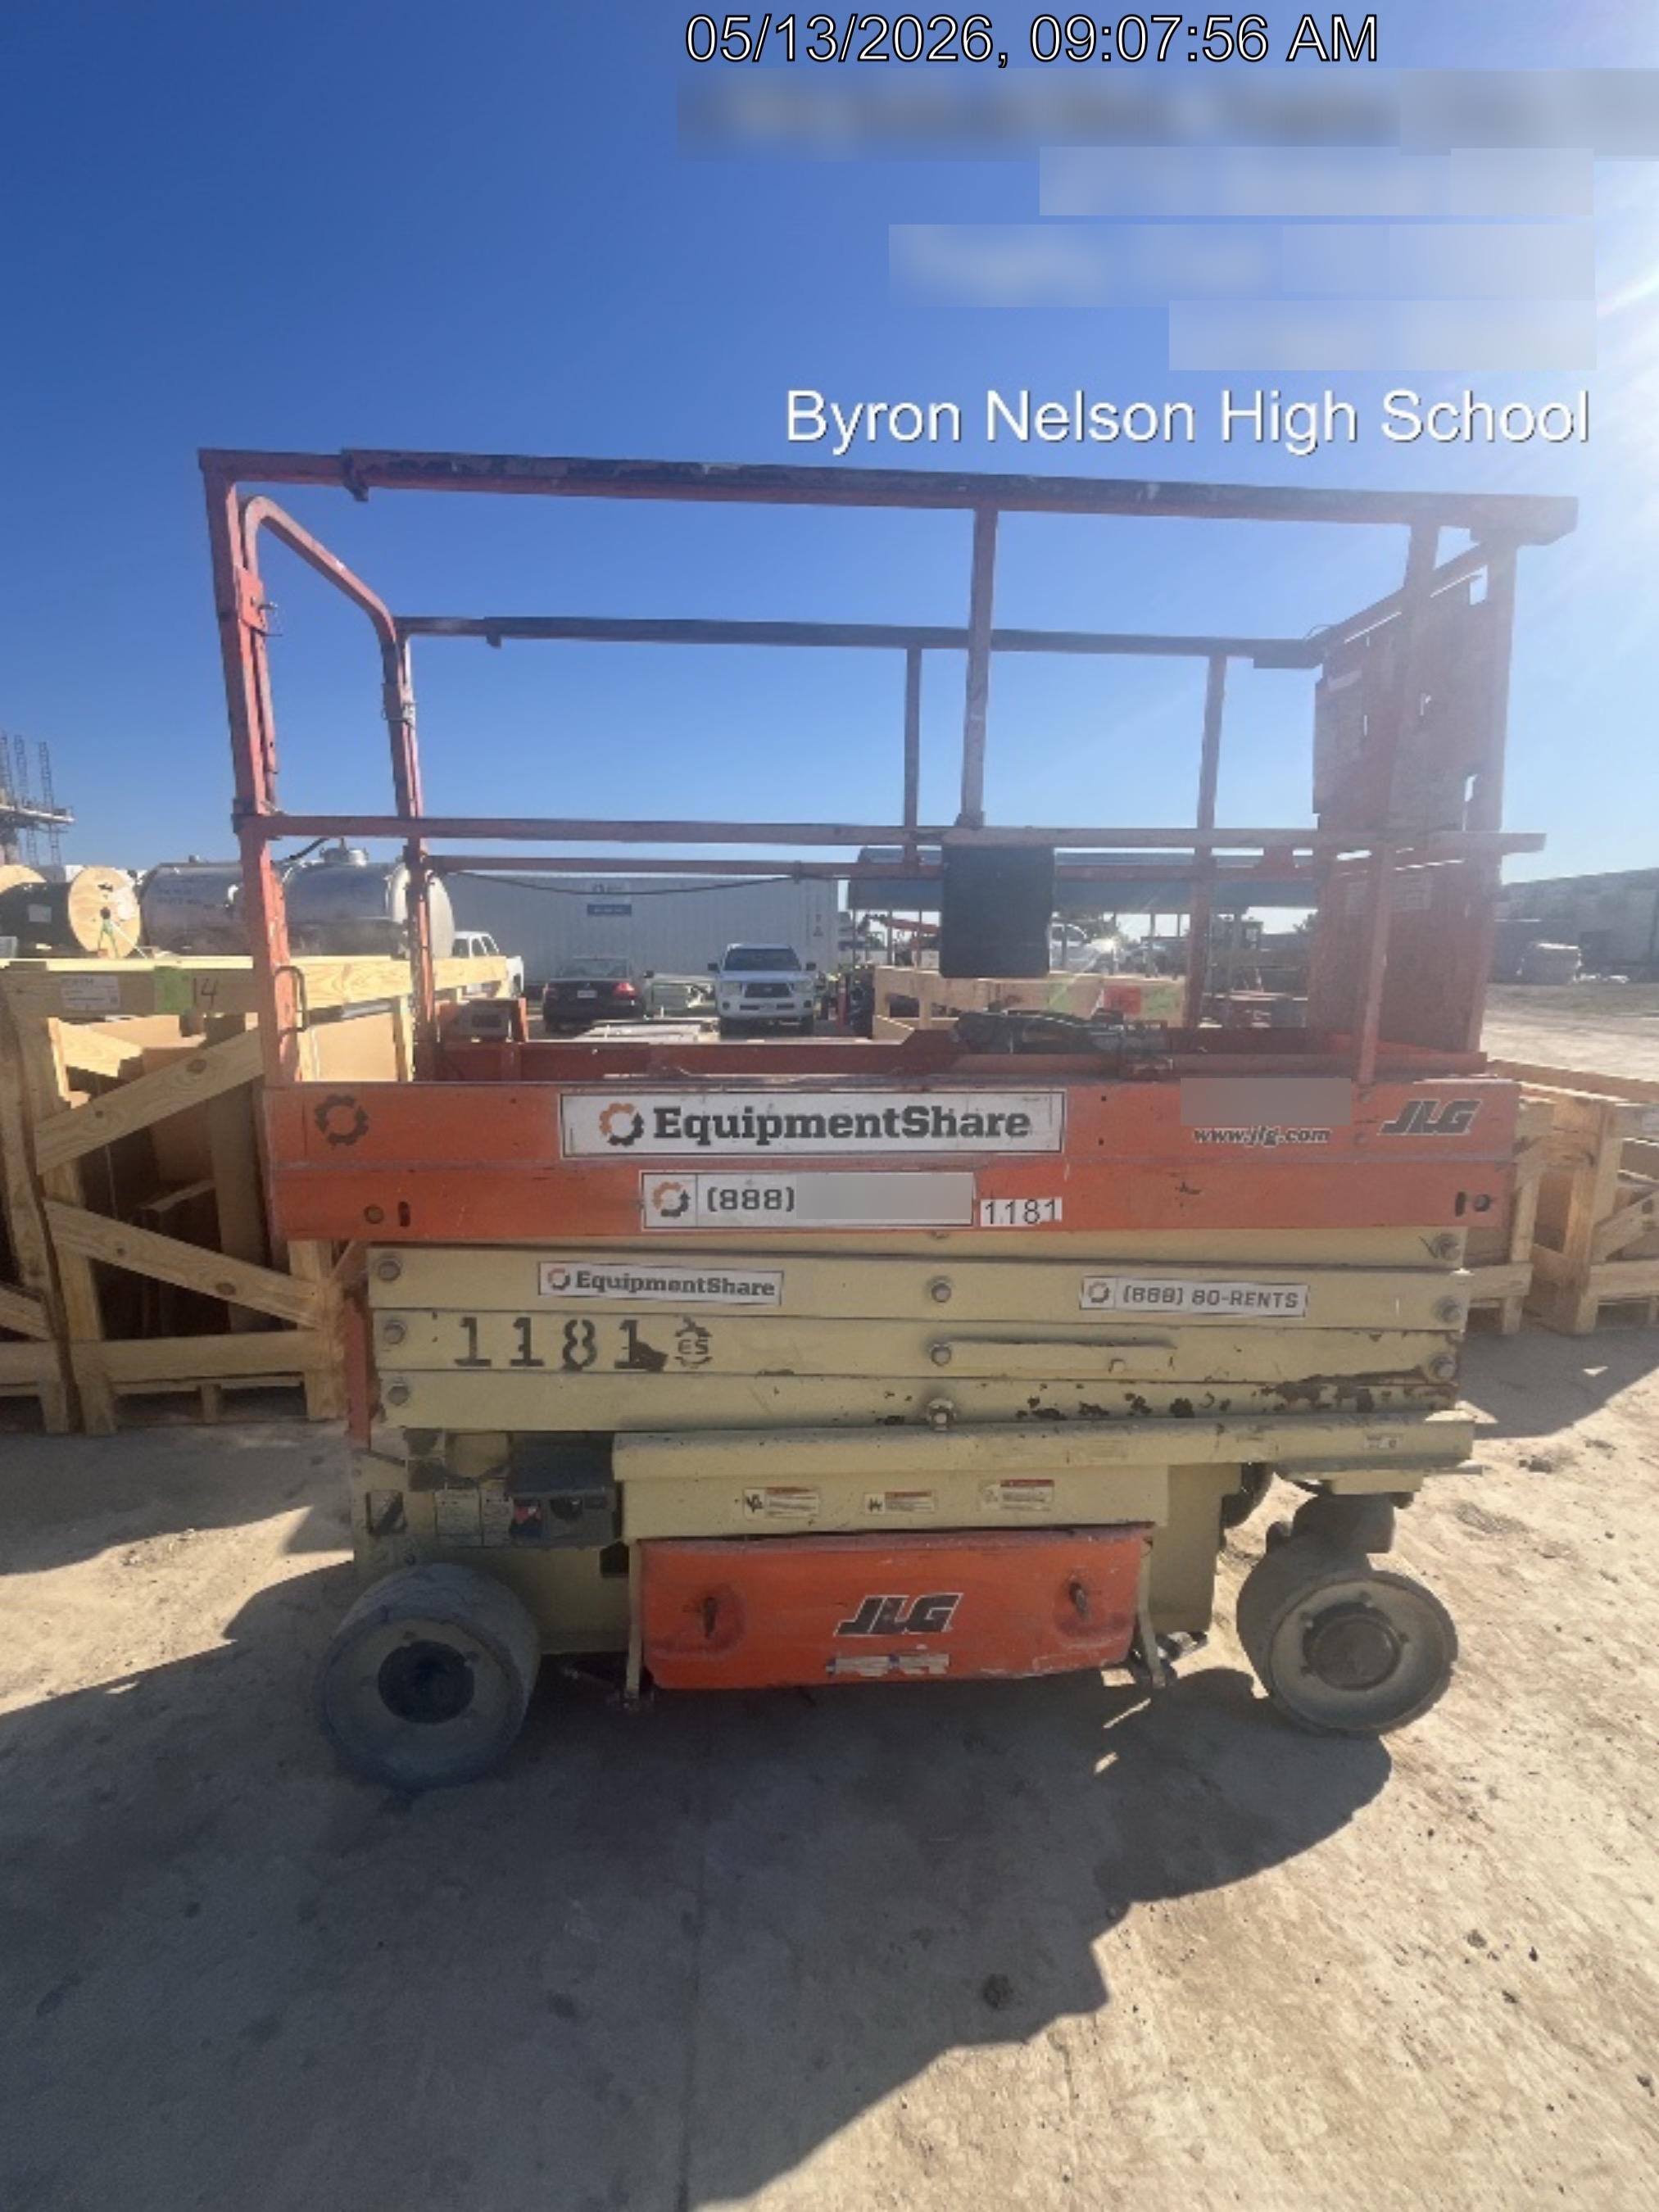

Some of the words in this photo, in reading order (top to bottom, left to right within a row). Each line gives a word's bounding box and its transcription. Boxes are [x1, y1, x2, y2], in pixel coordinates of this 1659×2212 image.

[653, 1105, 1031, 1145] EquipmentShare
[1376, 1099, 1482, 1135] JLG
[706, 1185, 796, 1213] (888)
[984, 1199, 1058, 1225] 1181
[575, 1270, 776, 1297] EquipmentShare
[454, 1316, 657, 1371] 1181
[832, 1592, 964, 1637] JLG
